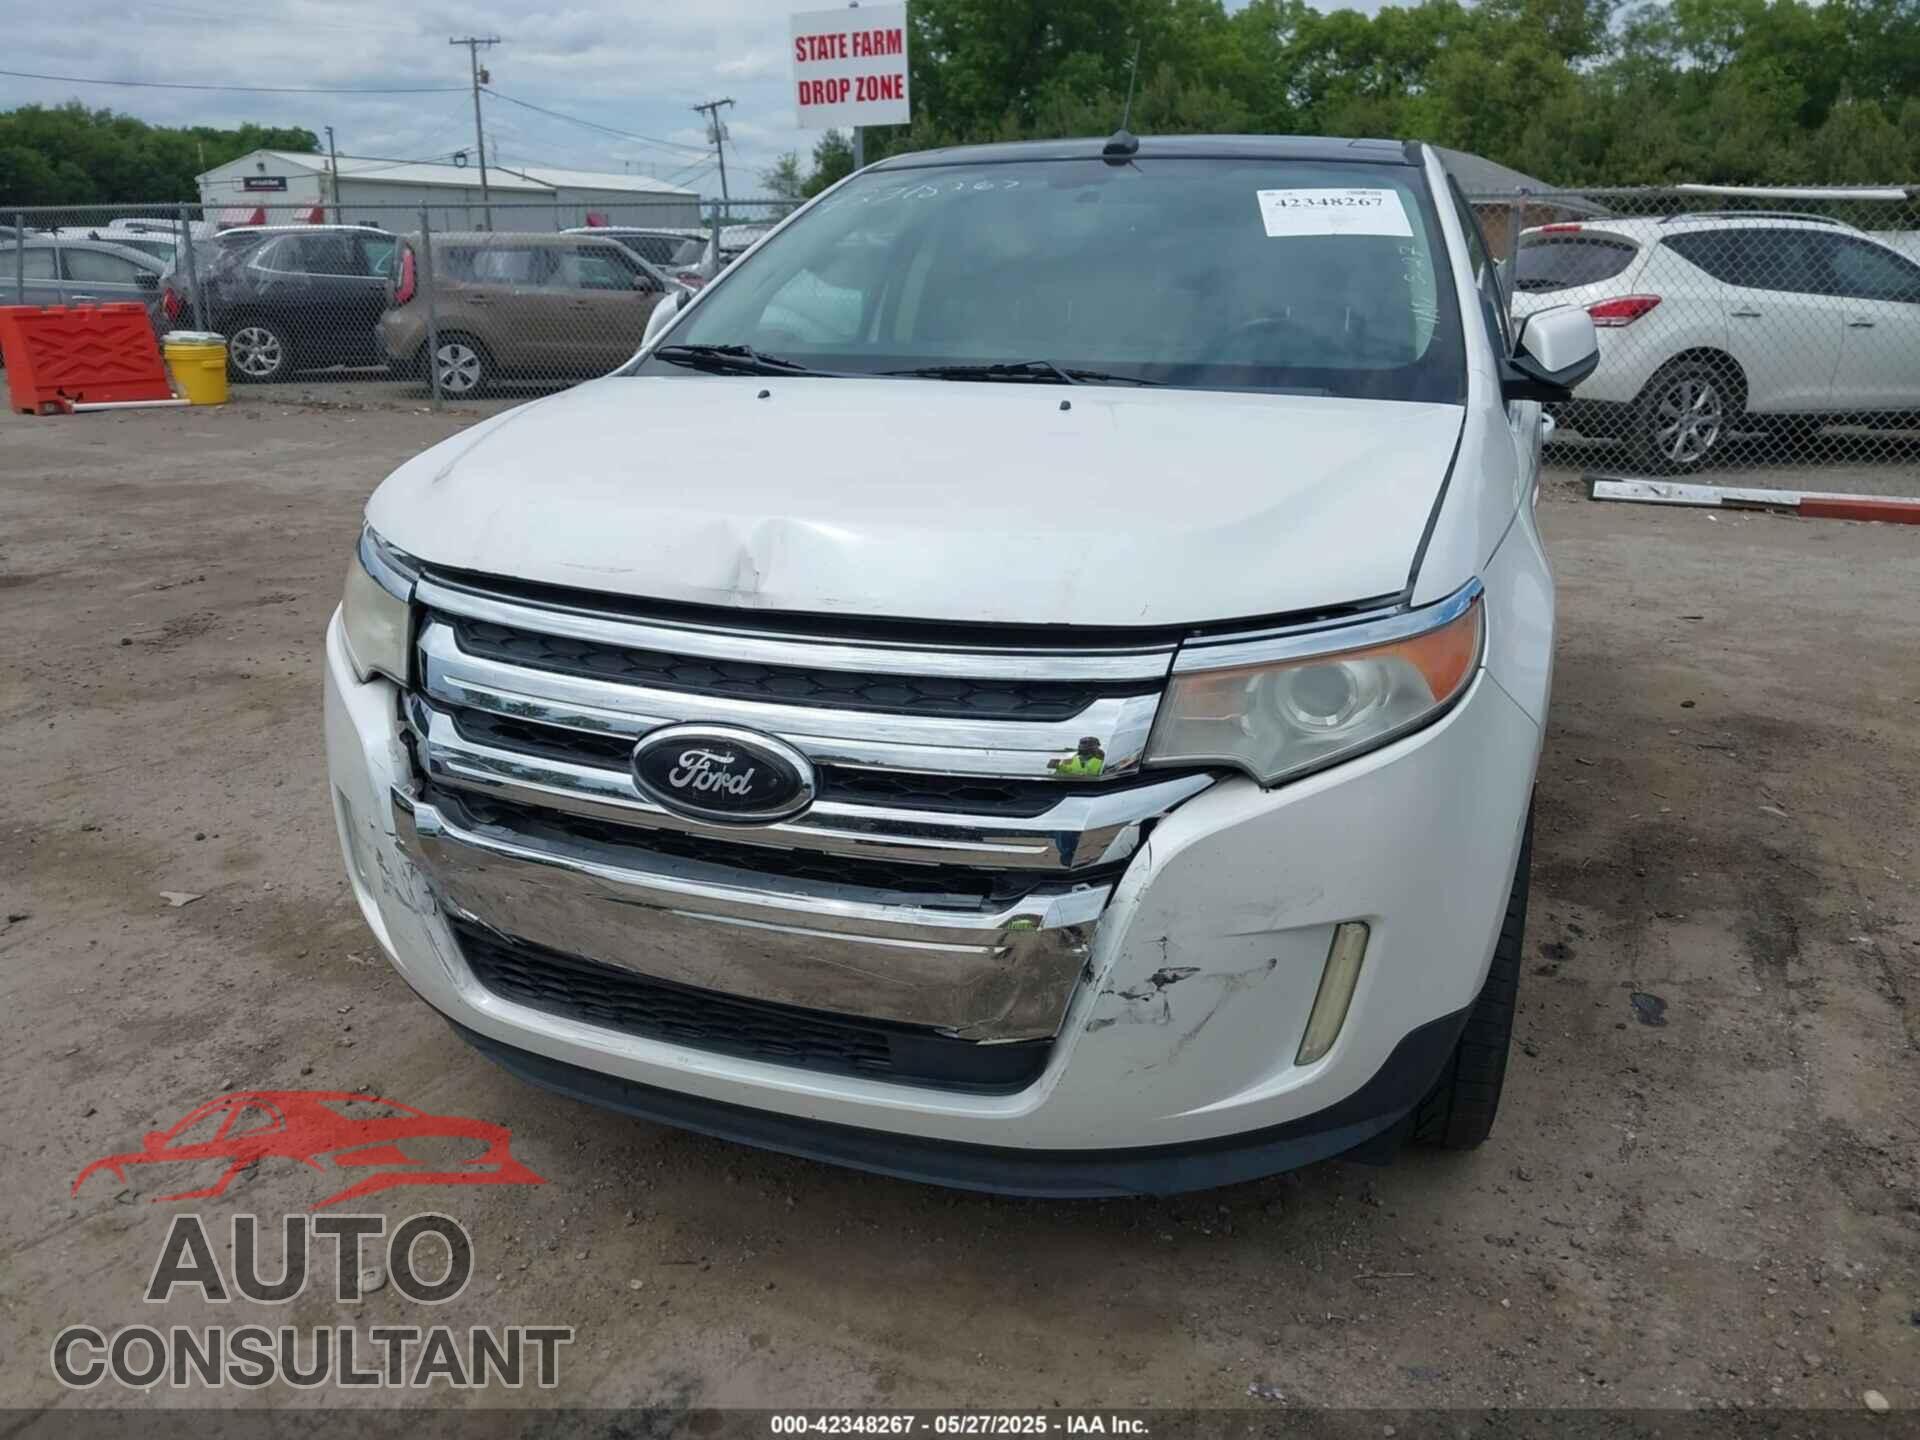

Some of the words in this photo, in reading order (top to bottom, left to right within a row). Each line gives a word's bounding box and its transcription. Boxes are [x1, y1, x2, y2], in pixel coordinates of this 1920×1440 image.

[795, 33, 848, 62] STATE
[852, 28, 903, 57] FARM
[798, 78, 850, 106] DROP
[855, 74, 904, 102] ZONE
[1275, 197, 1383, 208] 42348267
[669, 749, 752, 795] Ford
